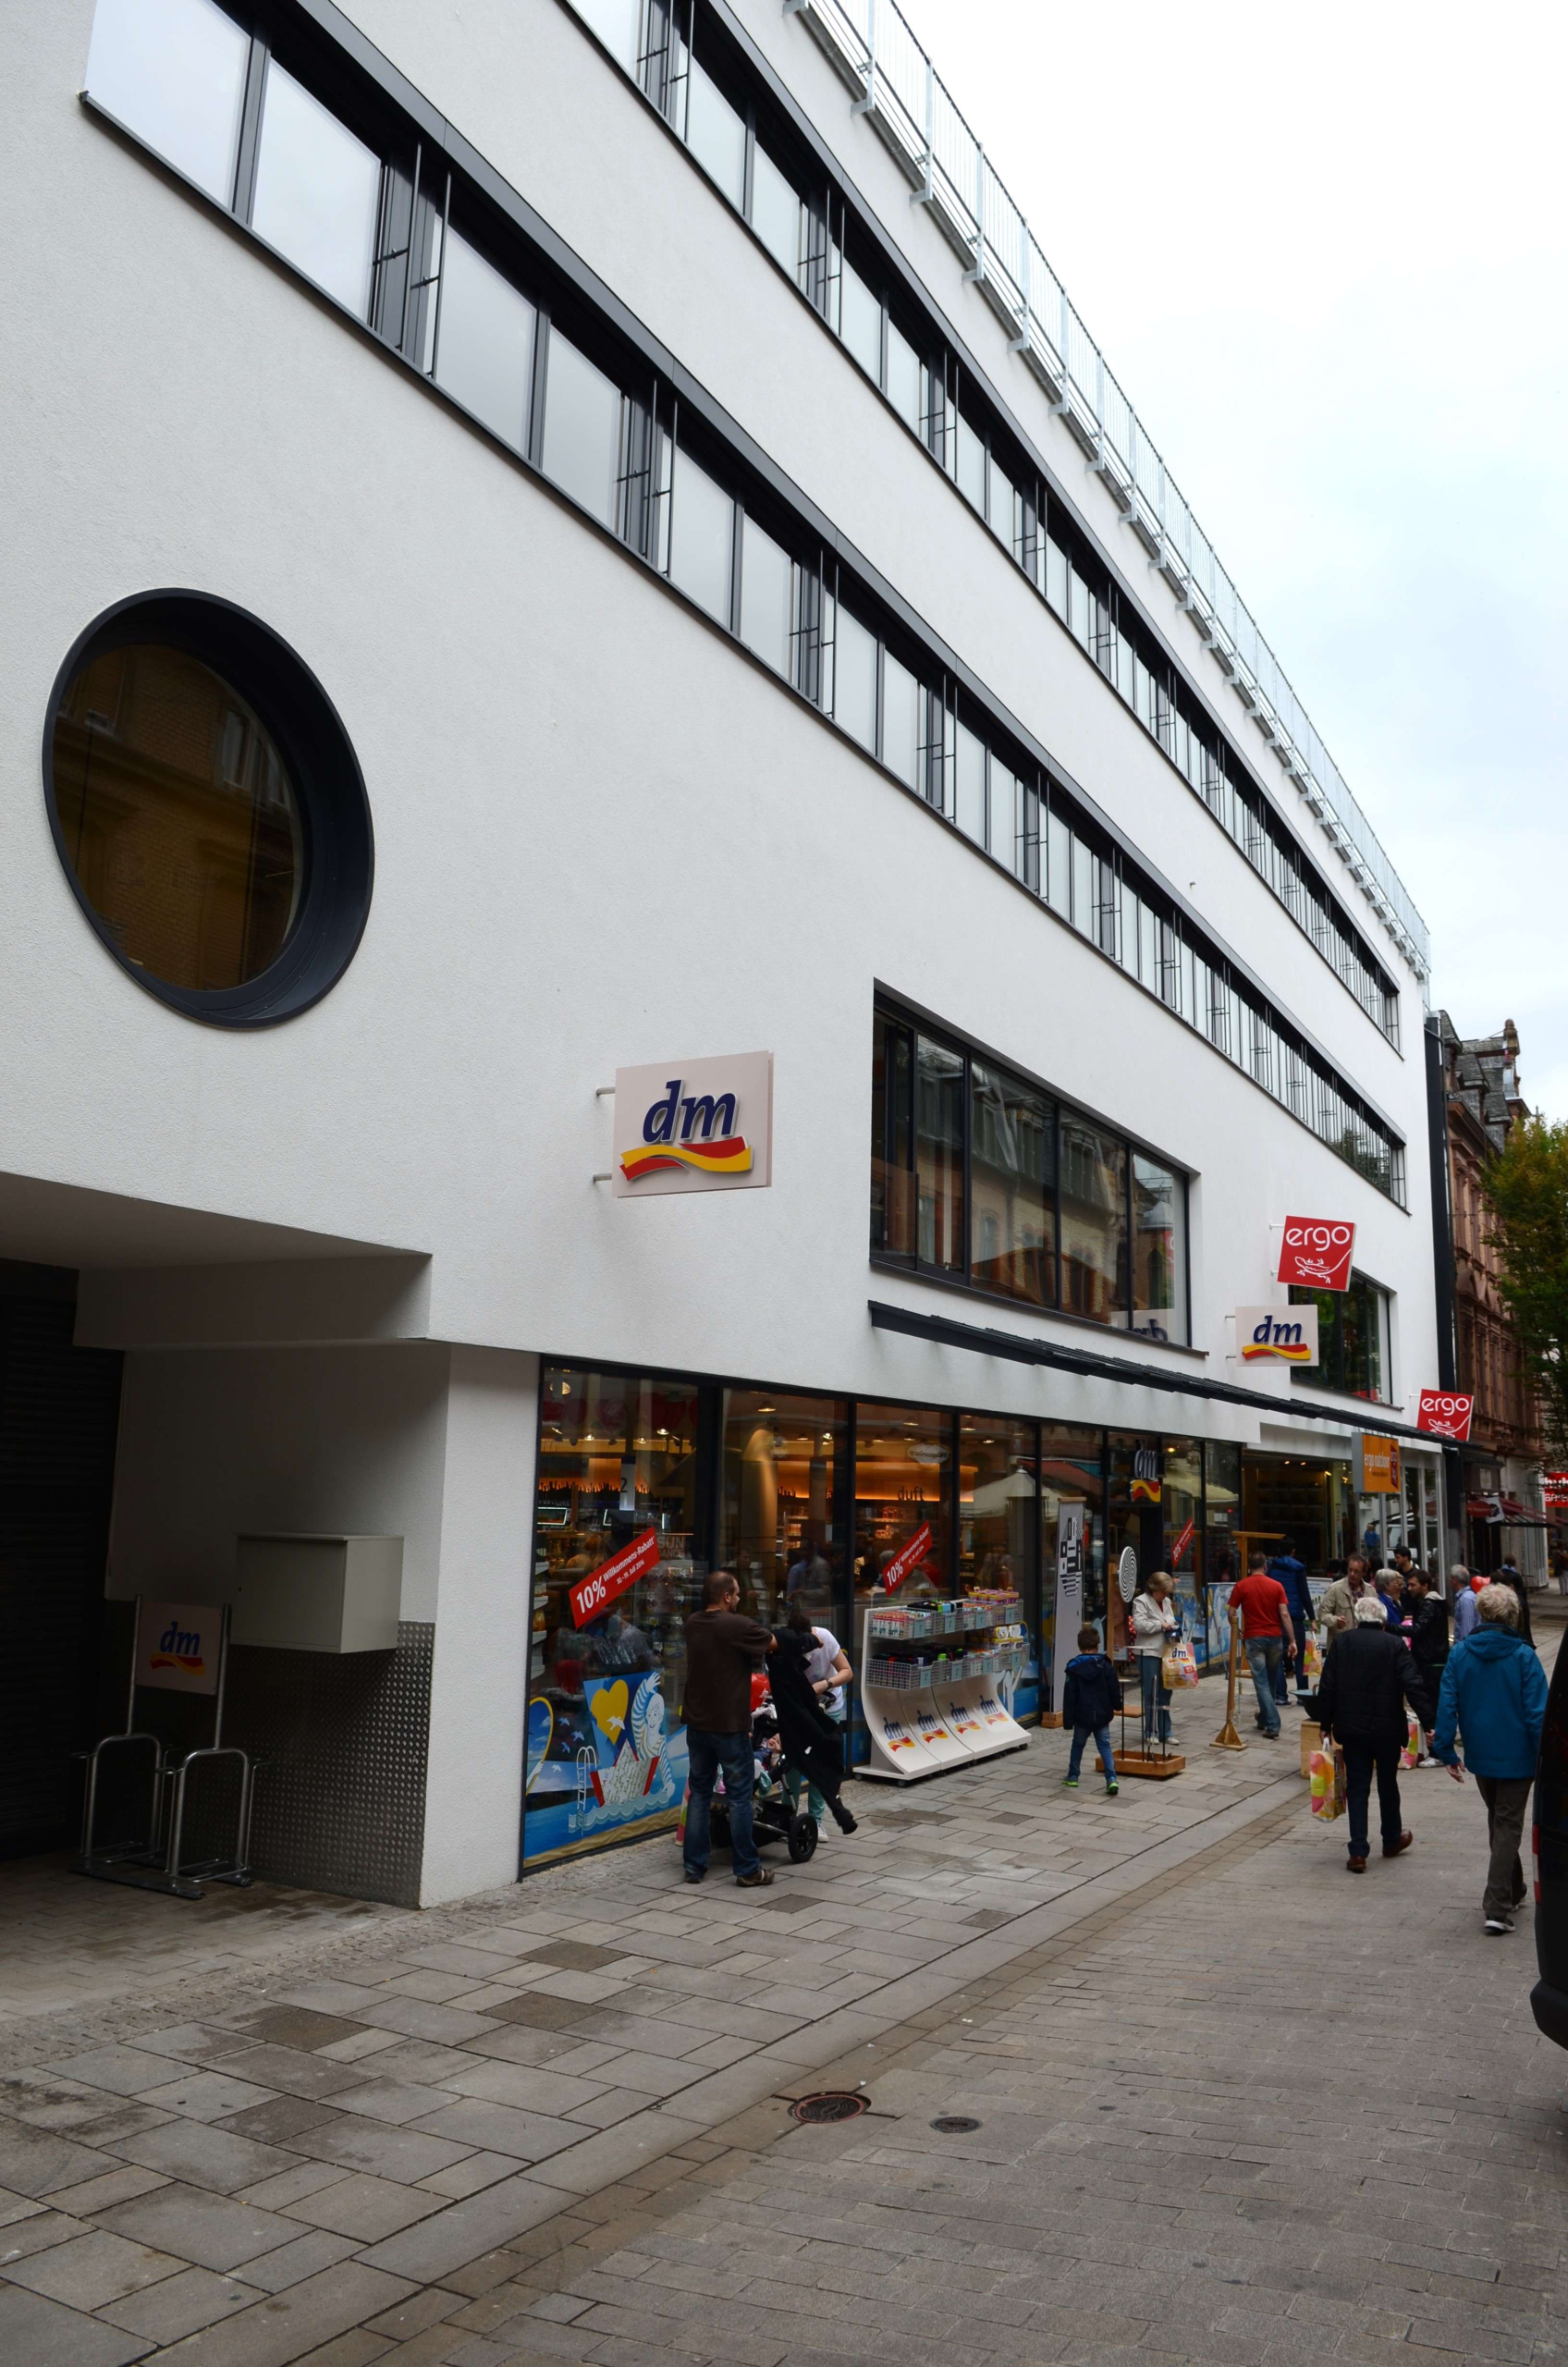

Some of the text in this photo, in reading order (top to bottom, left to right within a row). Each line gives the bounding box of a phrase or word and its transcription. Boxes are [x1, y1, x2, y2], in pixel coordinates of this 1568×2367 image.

[643, 1079, 738, 1145] dm
[1285, 1225, 1351, 1252] ergo
[1253, 1315, 1303, 1344] dm
[1421, 1396, 1470, 1417] ergo
[1134, 1439, 1158, 1479] dm
[897, 1485, 925, 1502] duft
[657, 1536, 685, 1549] SUN
[887, 1558, 903, 1587] 10%
[577, 1576, 606, 1613] 10%
[160, 1621, 202, 1656] dm
[1171, 1647, 1186, 1659] dm
[950, 1702, 970, 1723] dm
[980, 1695, 998, 1715] dm
[884, 1717, 905, 1740] dm
[917, 1710, 937, 1732] dm
